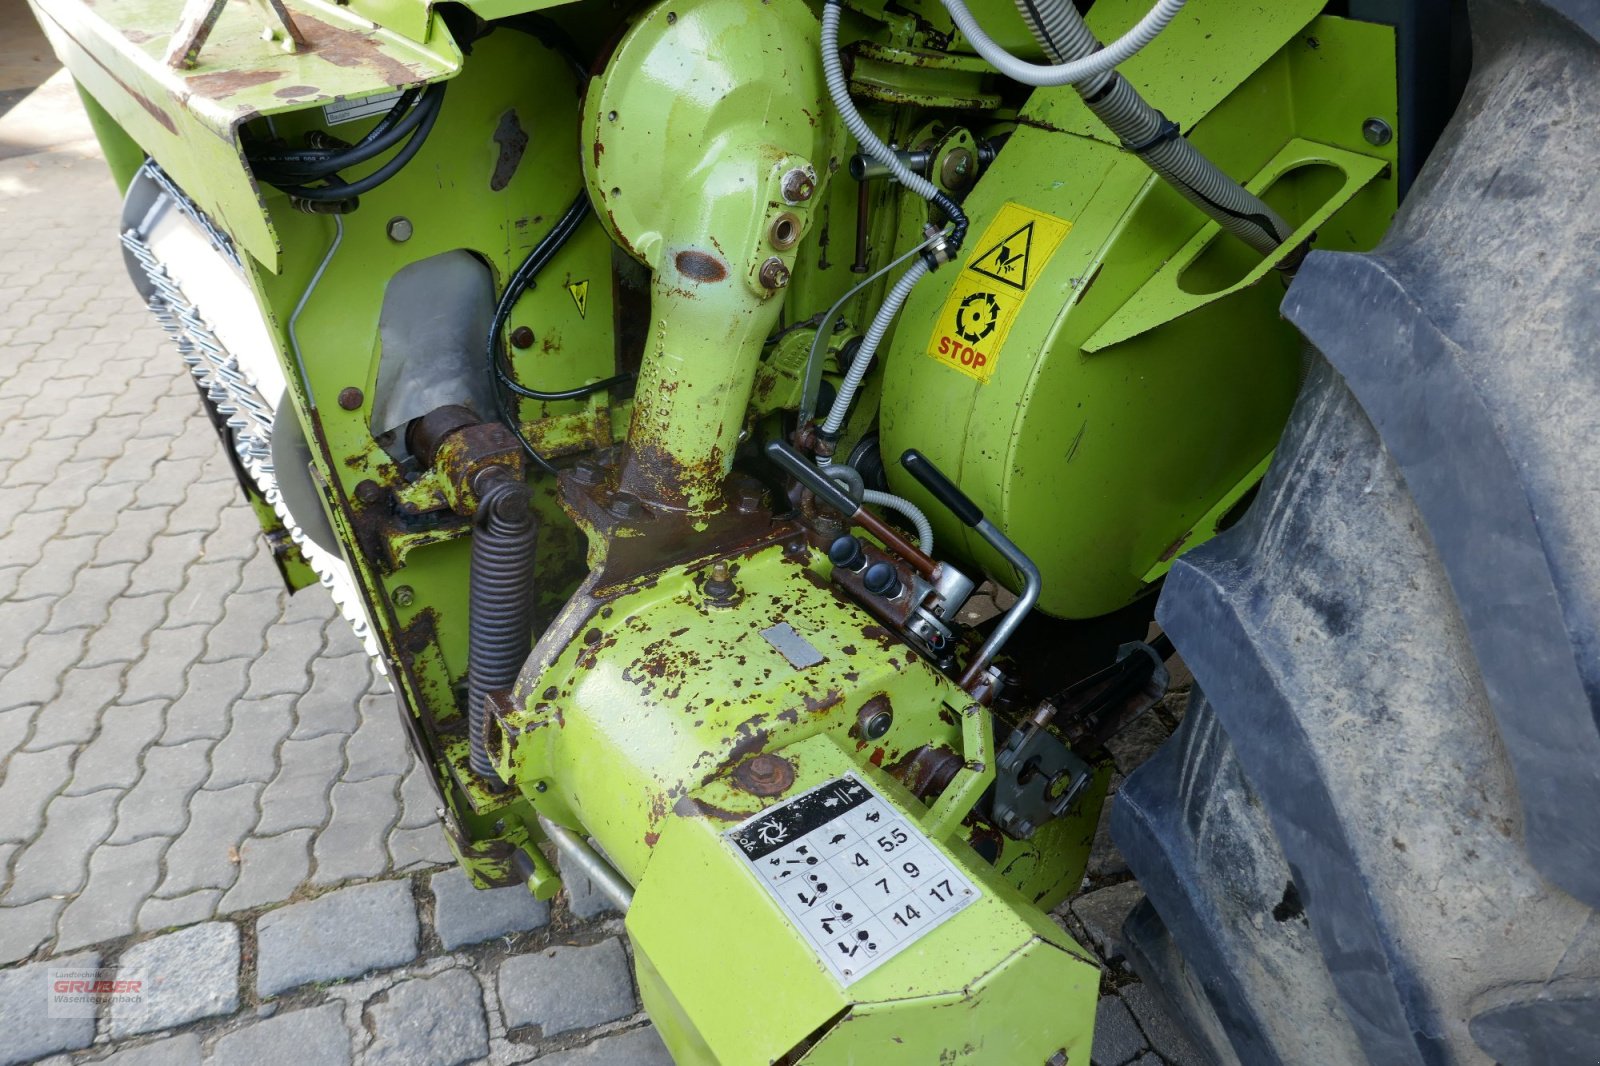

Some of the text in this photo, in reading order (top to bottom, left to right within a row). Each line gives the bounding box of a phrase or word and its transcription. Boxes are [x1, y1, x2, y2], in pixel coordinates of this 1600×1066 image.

[938, 336, 987, 369] STOP
[877, 828, 908, 853] 5.5
[854, 852, 869, 868] 4
[902, 862, 920, 878] 9
[875, 878, 891, 894] 7
[929, 879, 955, 903] 17
[893, 904, 922, 927] 14
